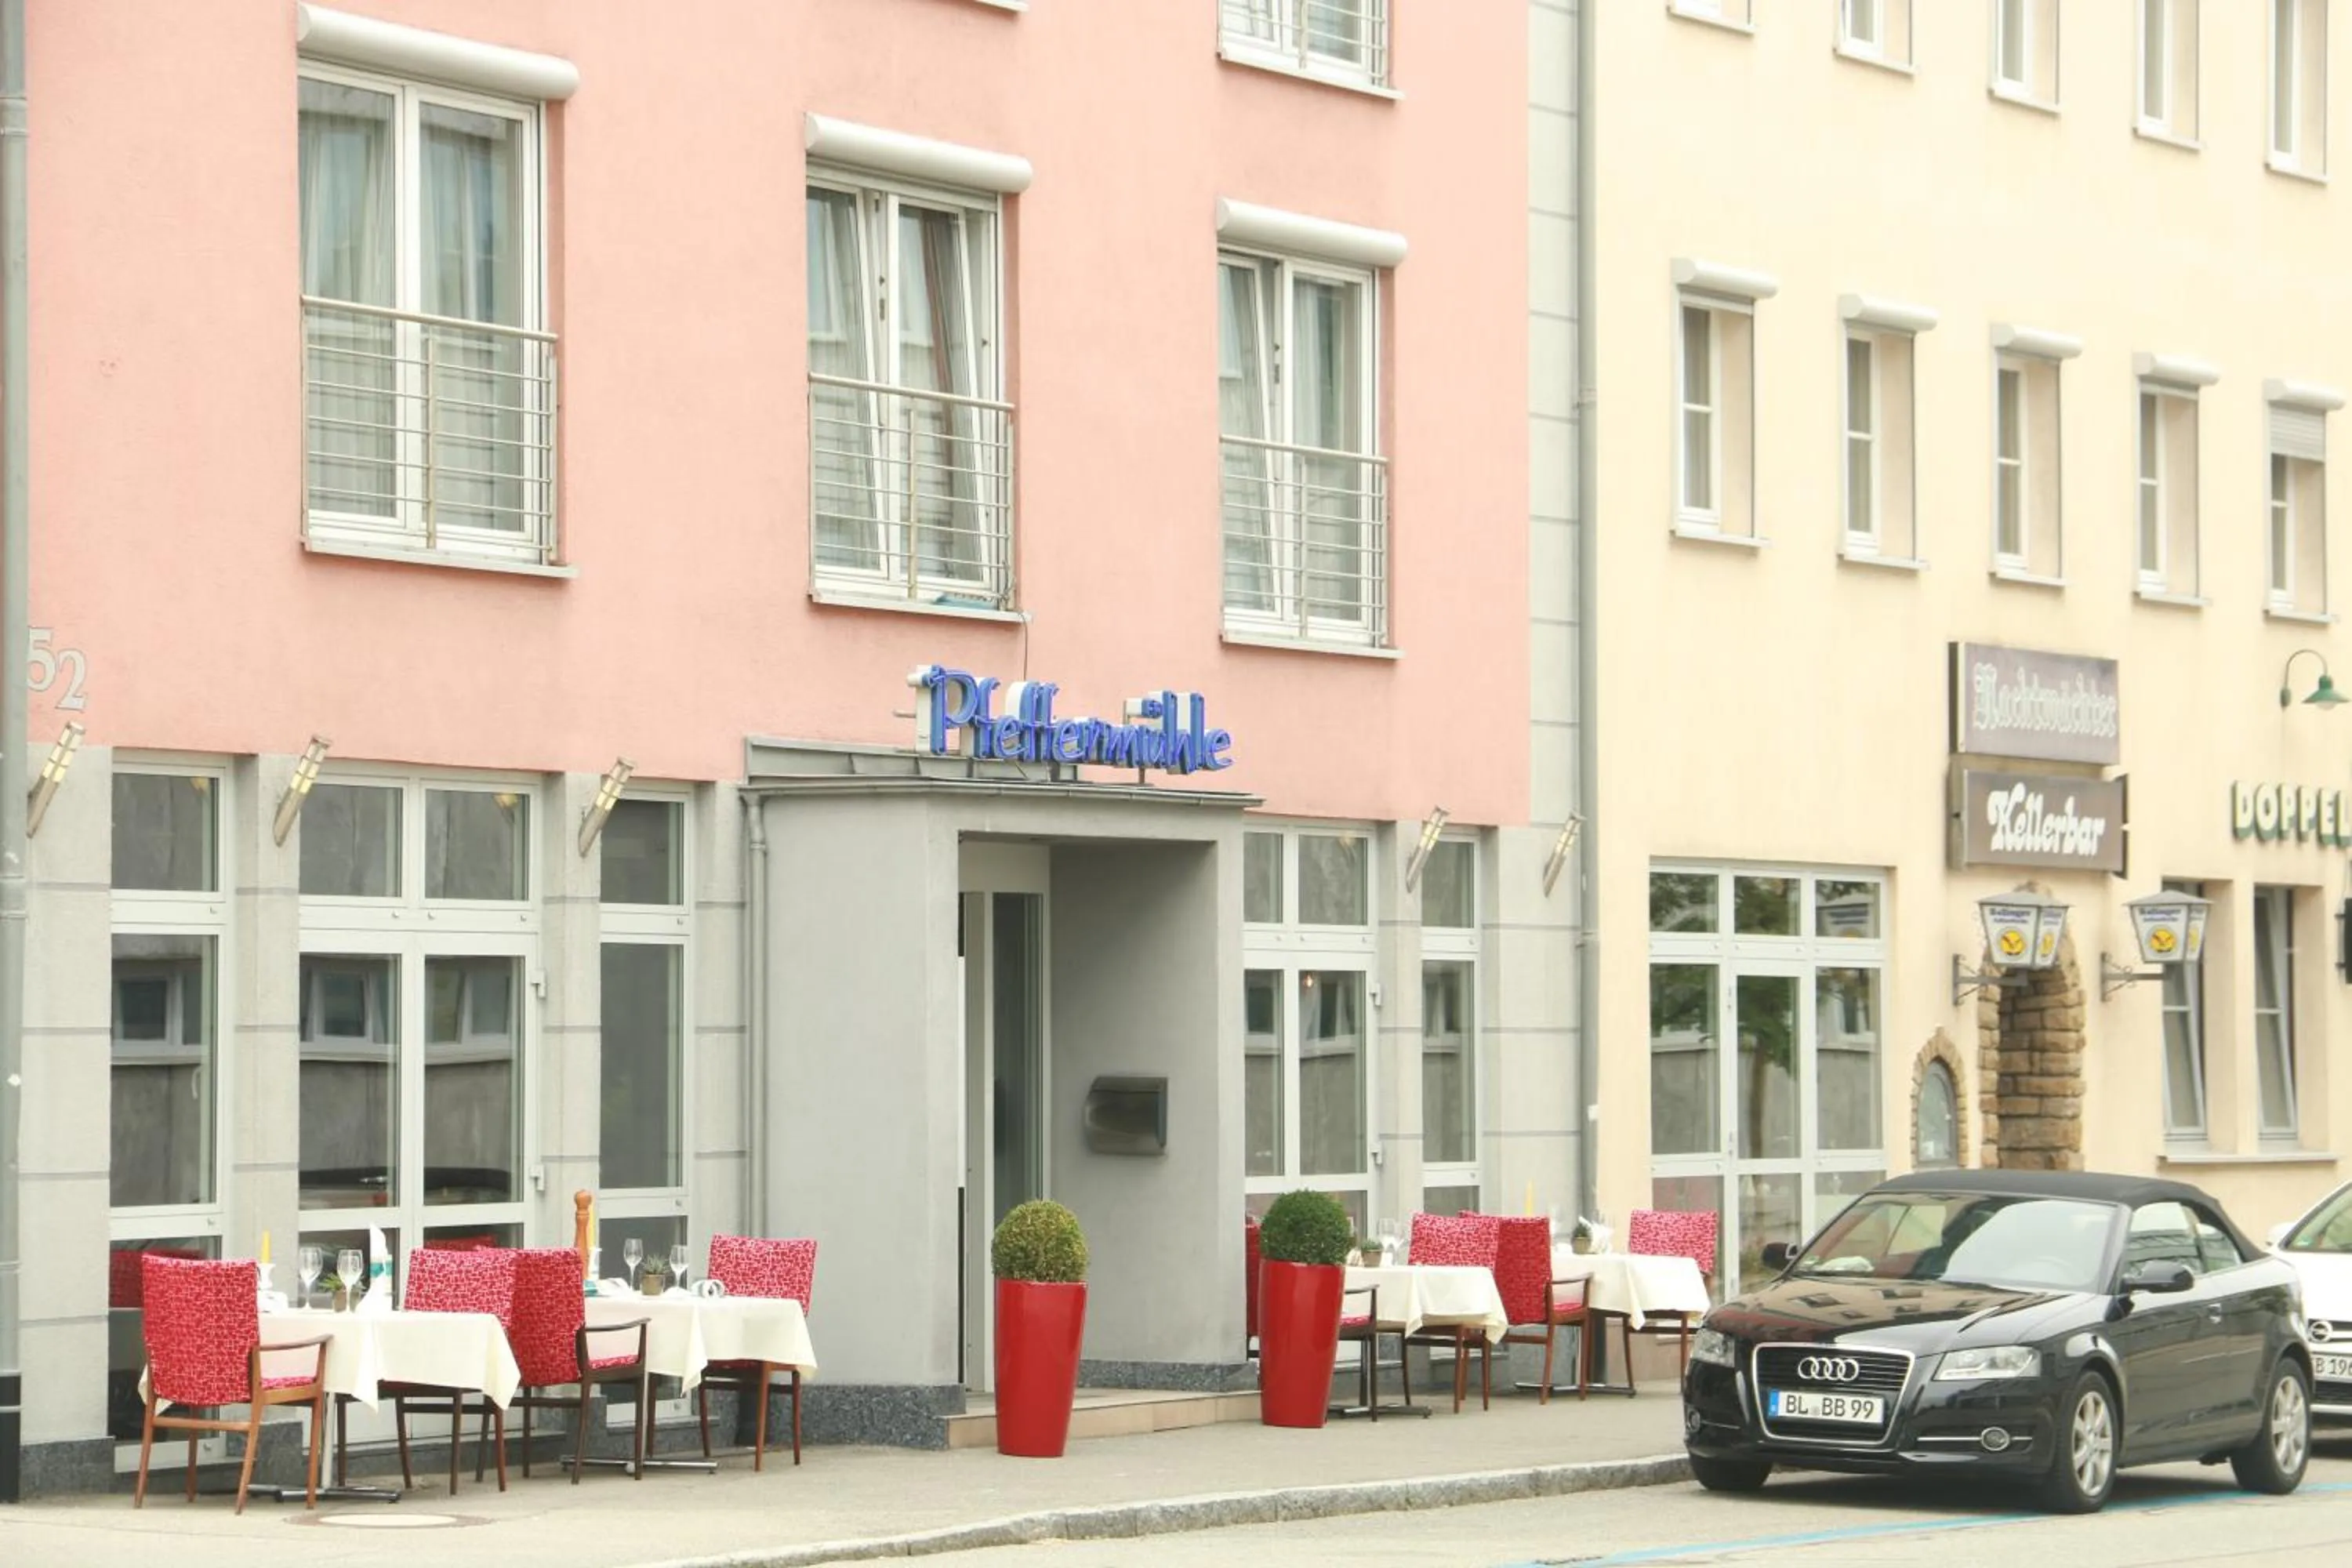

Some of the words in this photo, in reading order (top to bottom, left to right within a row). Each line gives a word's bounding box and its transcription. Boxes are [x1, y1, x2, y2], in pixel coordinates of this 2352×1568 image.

[27, 626, 88, 713] 52
[909, 664, 1233, 775] Pfeffermühle
[1987, 782, 2106, 856] Kellerbar
[1785, 1395, 1808, 1415] BL
[1821, 1397, 1846, 1417] BB
[1851, 1399, 1874, 1419] 99
